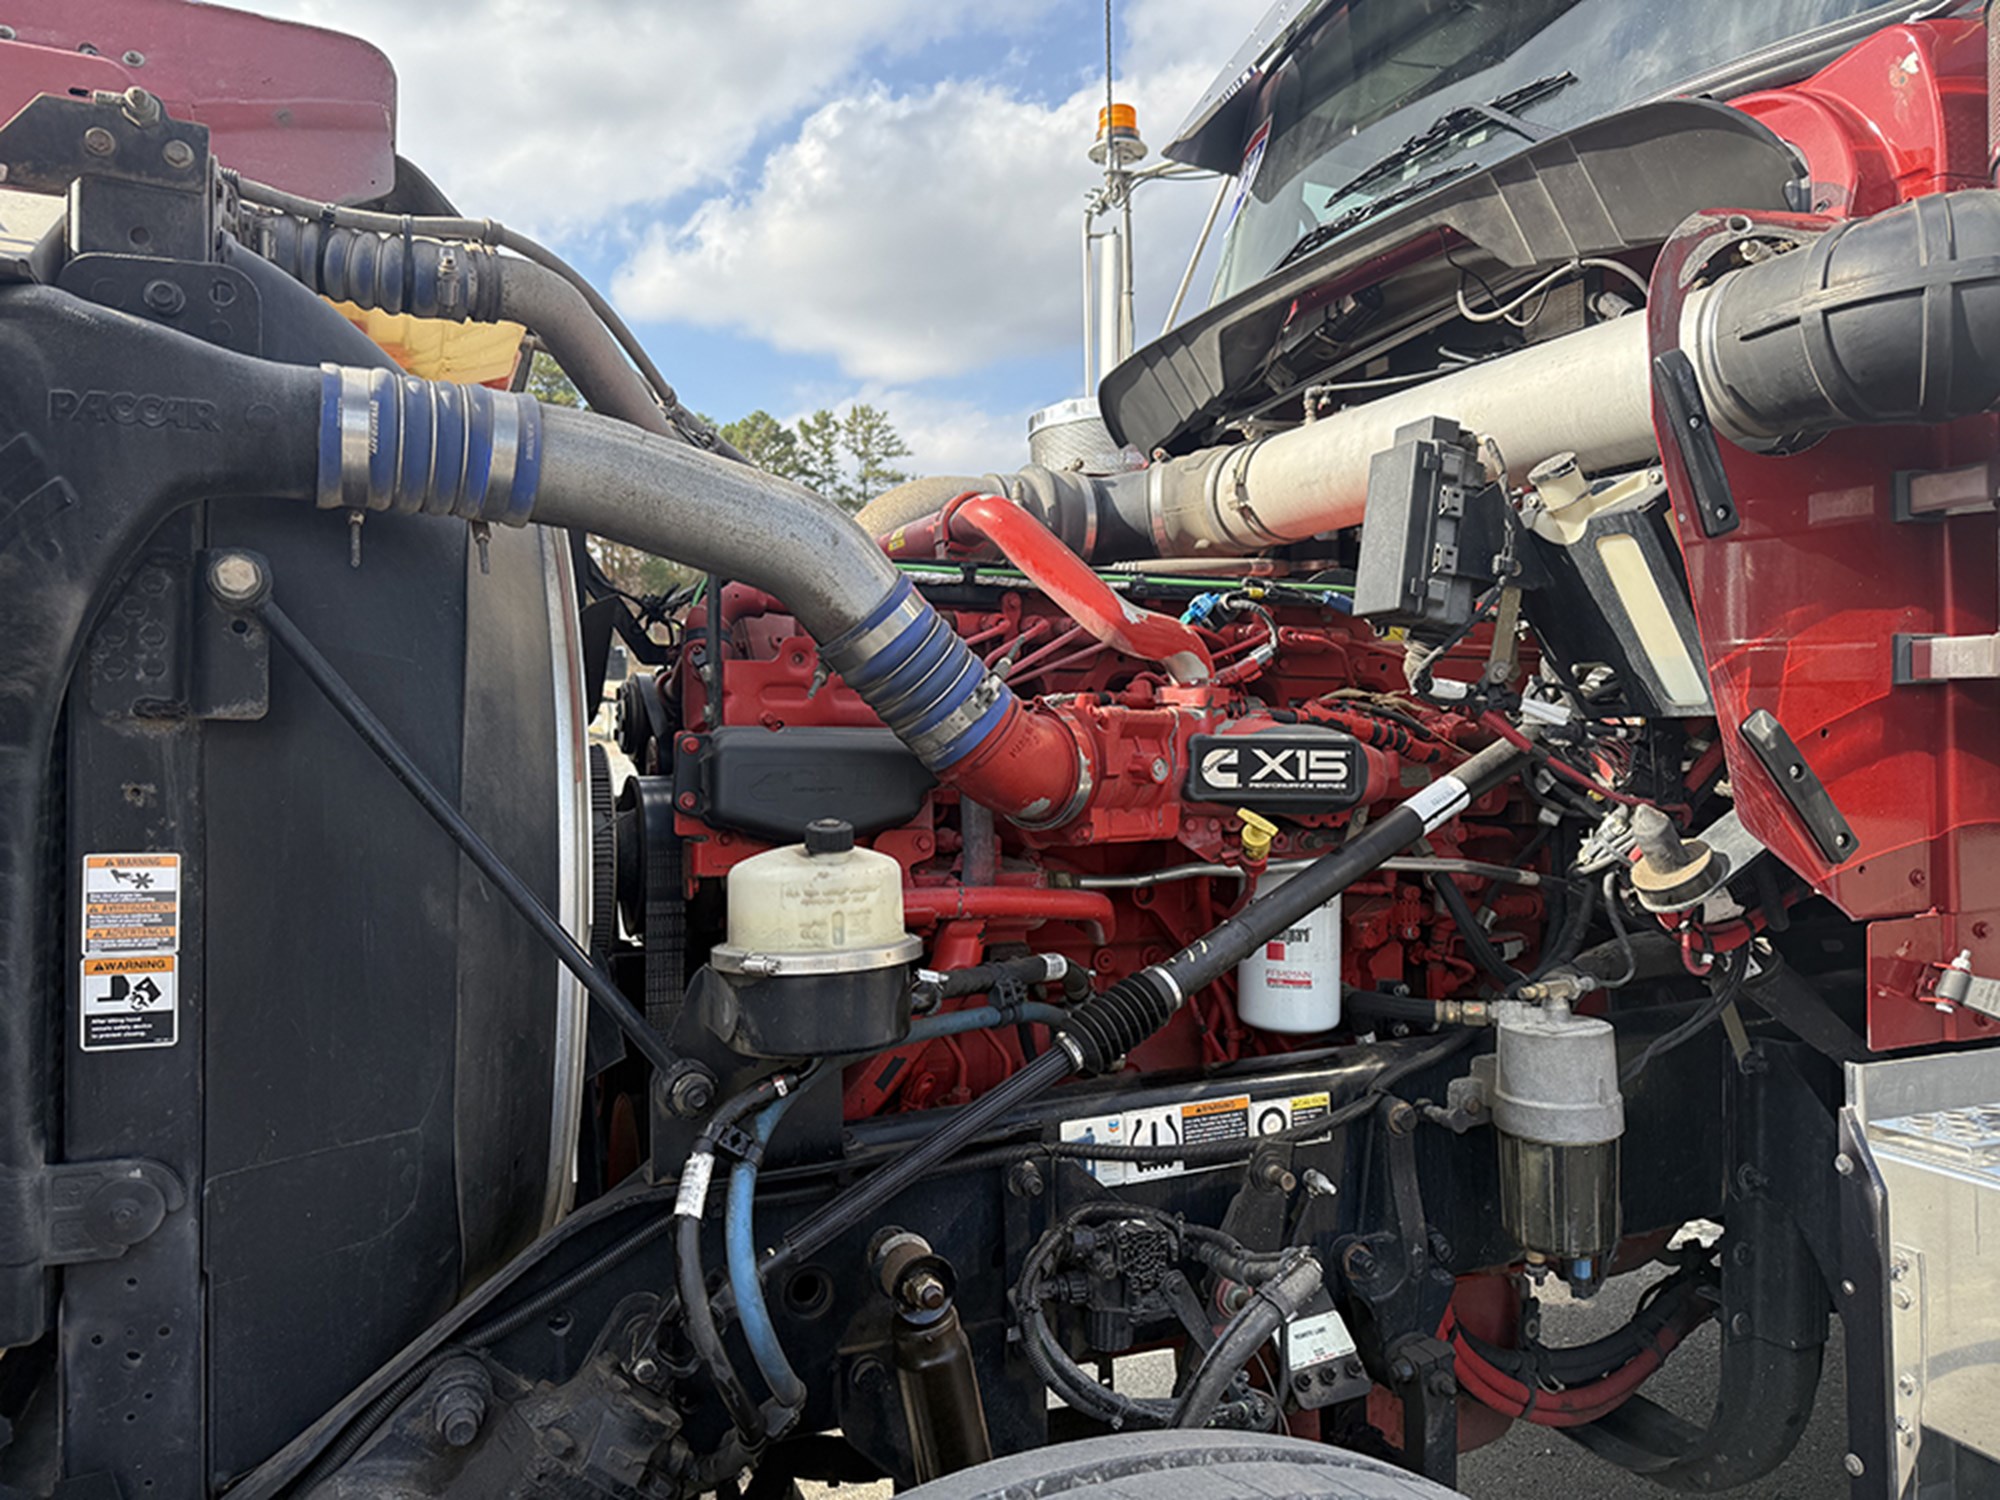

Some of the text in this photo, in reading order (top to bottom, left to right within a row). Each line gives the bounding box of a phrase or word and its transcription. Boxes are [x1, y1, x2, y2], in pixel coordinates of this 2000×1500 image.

[48, 389, 222, 432] PACCAR
[1250, 749, 1347, 781] X15
[117, 857, 160, 866] WARNING
[104, 960, 166, 971] WARNING
